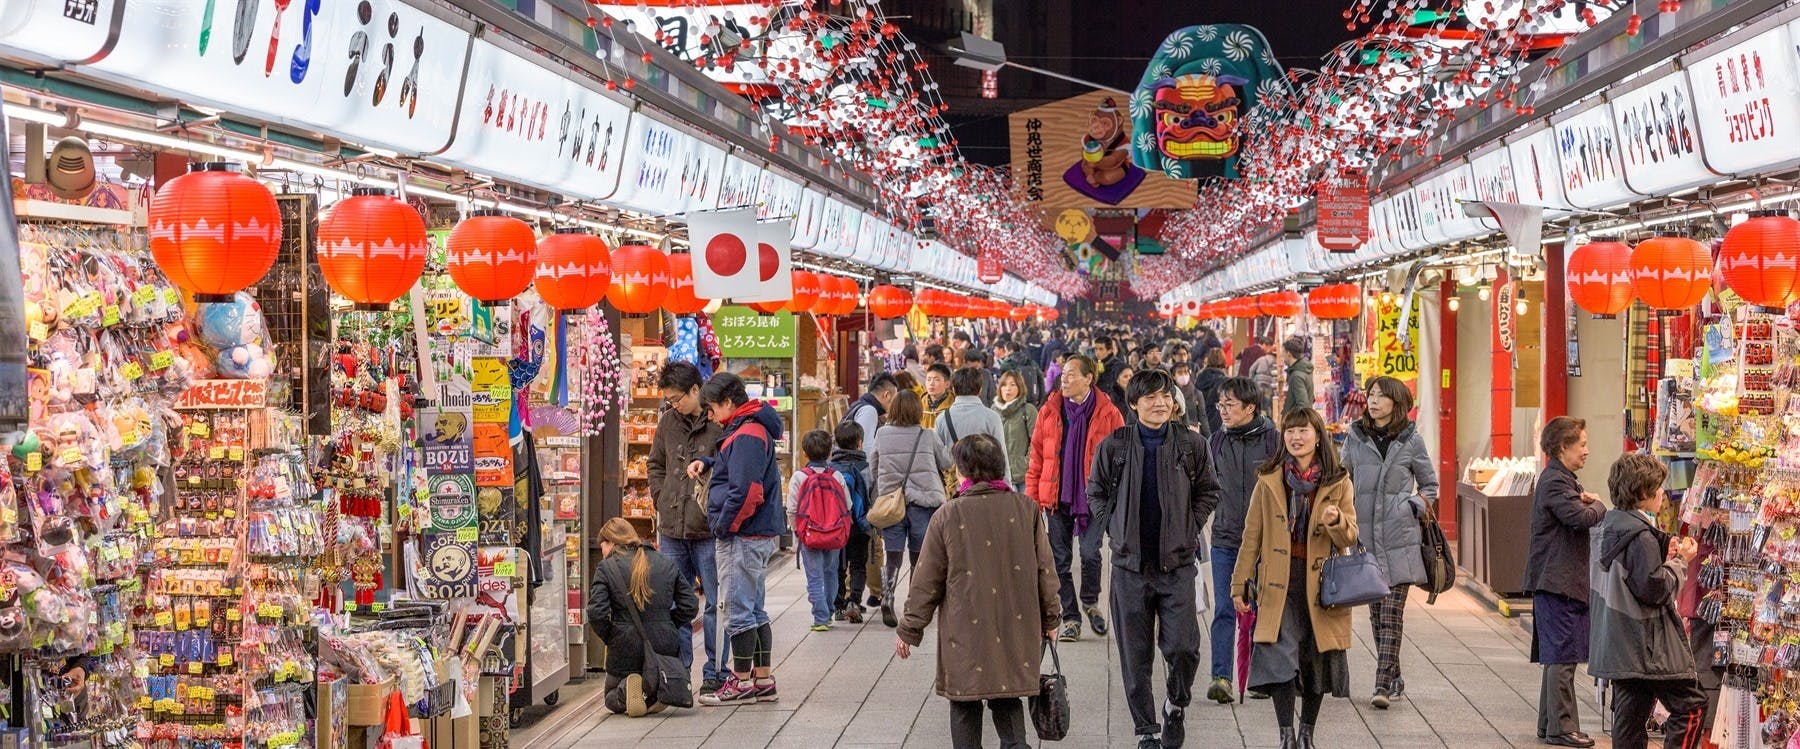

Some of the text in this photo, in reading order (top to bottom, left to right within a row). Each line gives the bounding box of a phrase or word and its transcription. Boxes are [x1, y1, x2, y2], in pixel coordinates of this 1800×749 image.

[1725, 98, 1775, 144] ショッピング
[1026, 118, 1043, 201] 仲見世商店会
[722, 316, 780, 328] おぼろ昆布
[723, 335, 790, 348] とろろこんぶ
[426, 451, 469, 465] BOZU
[479, 579, 507, 592] ides
